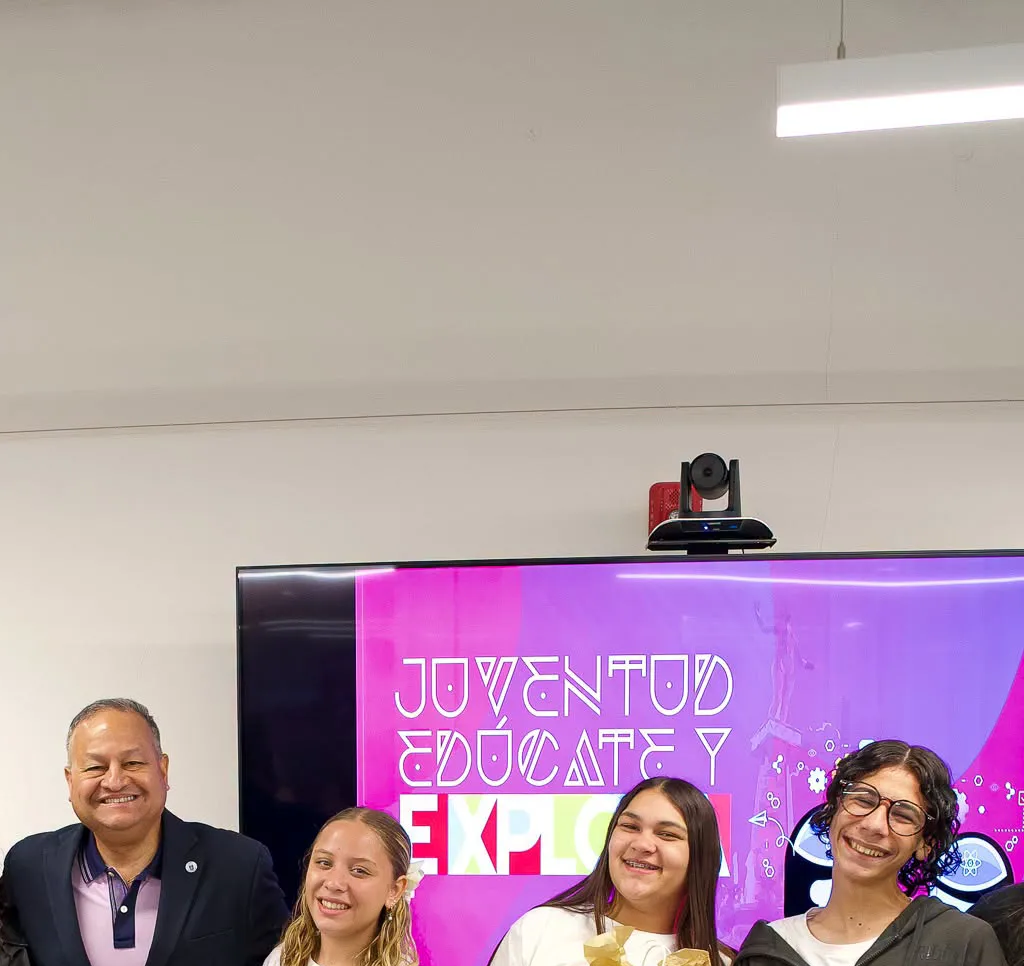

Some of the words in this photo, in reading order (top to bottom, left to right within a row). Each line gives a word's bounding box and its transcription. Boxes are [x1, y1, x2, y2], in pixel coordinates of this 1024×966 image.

[394, 653, 733, 718] JUVENTUD
[398, 715, 675, 787] EDÚCATE
[695, 727, 732, 786] Y
